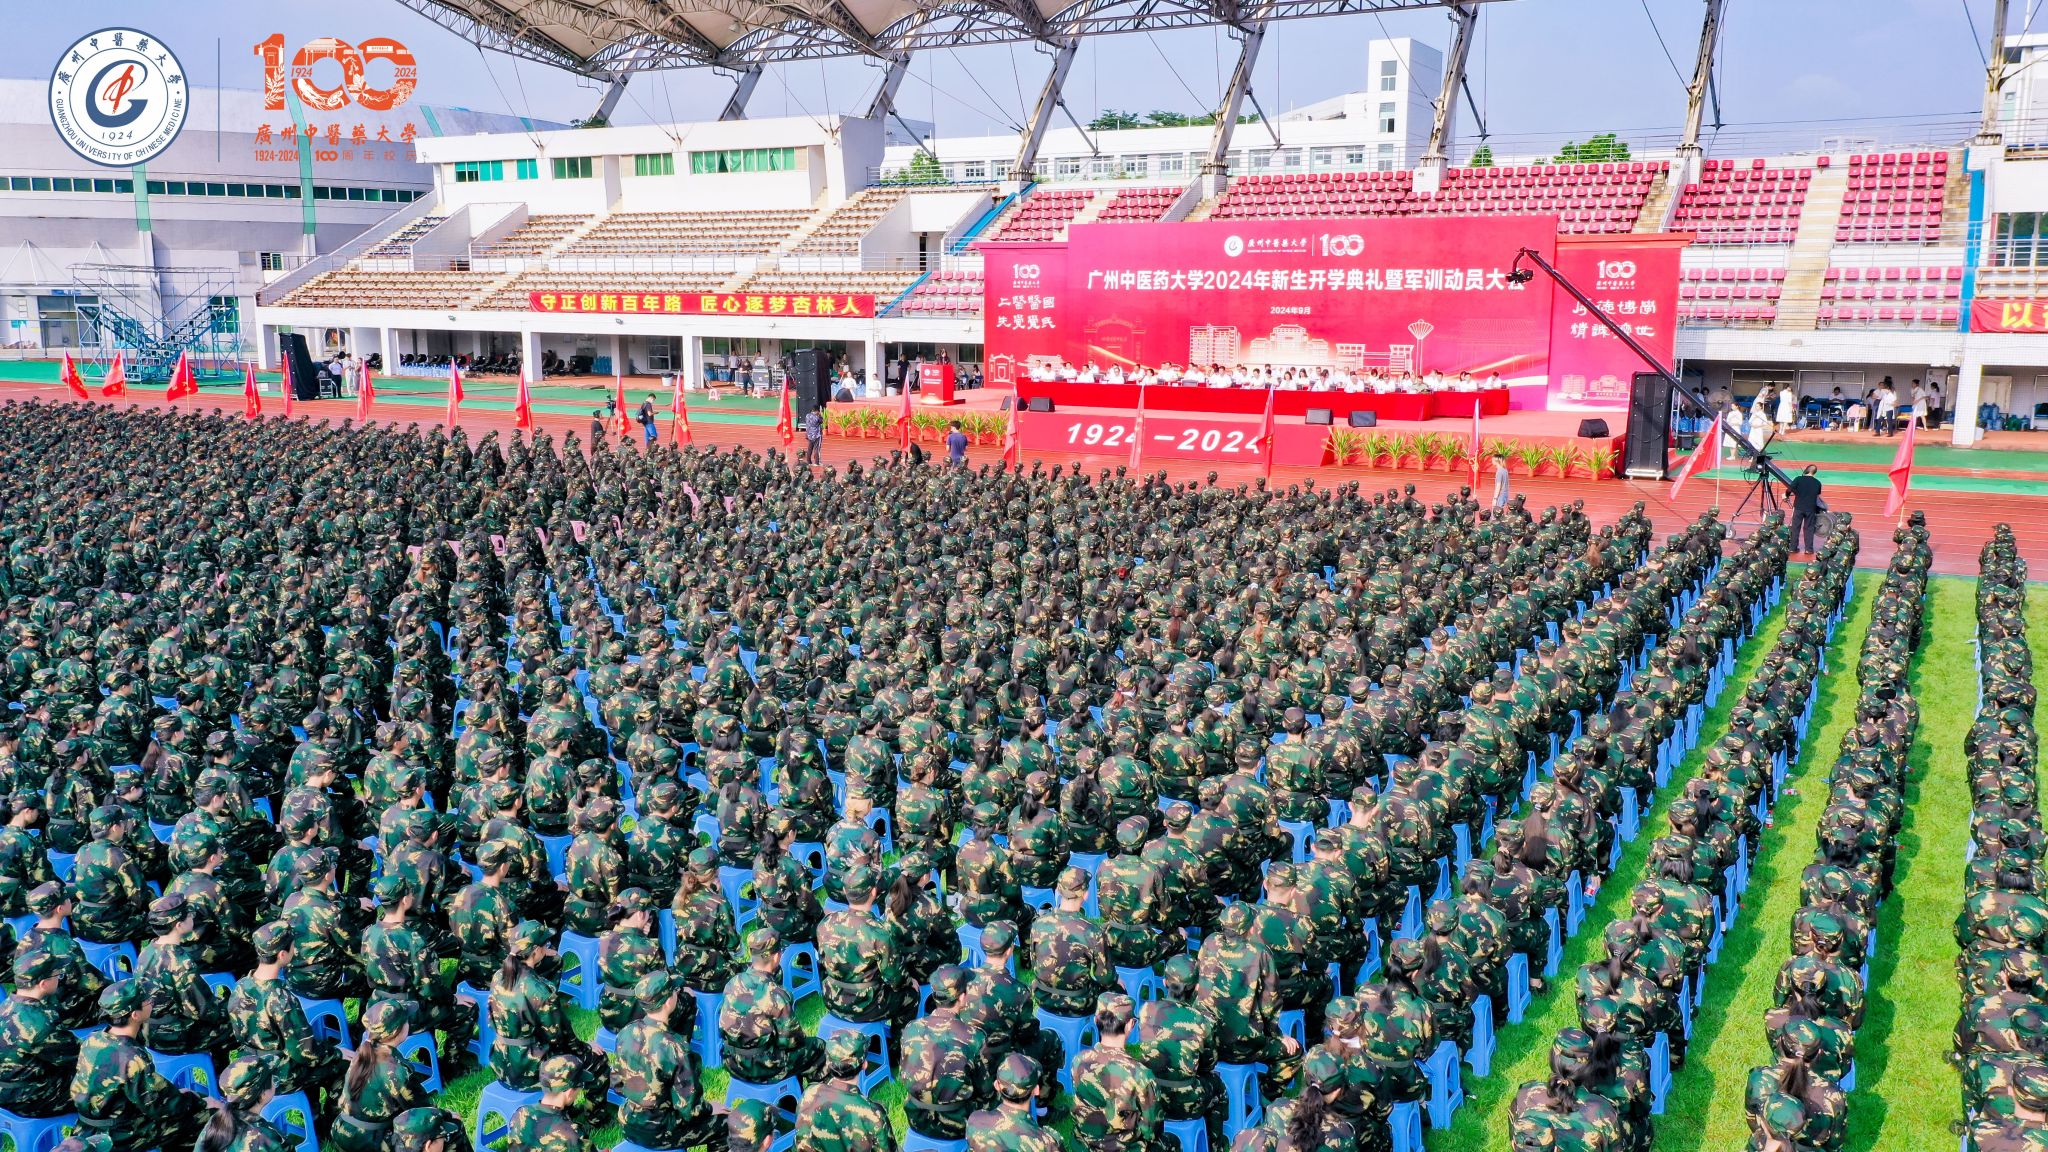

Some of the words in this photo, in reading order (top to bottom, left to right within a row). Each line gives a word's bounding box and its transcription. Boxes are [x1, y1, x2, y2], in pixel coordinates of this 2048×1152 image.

[1319, 233, 1365, 257] 100
[1013, 263, 1041, 279] 100
[1597, 260, 1638, 279] 100
[540, 294, 682, 312] 守正创新百年路
[700, 295, 860, 315] 匠心逐梦杏林人
[1270, 306, 1312, 315] 2024年9月
